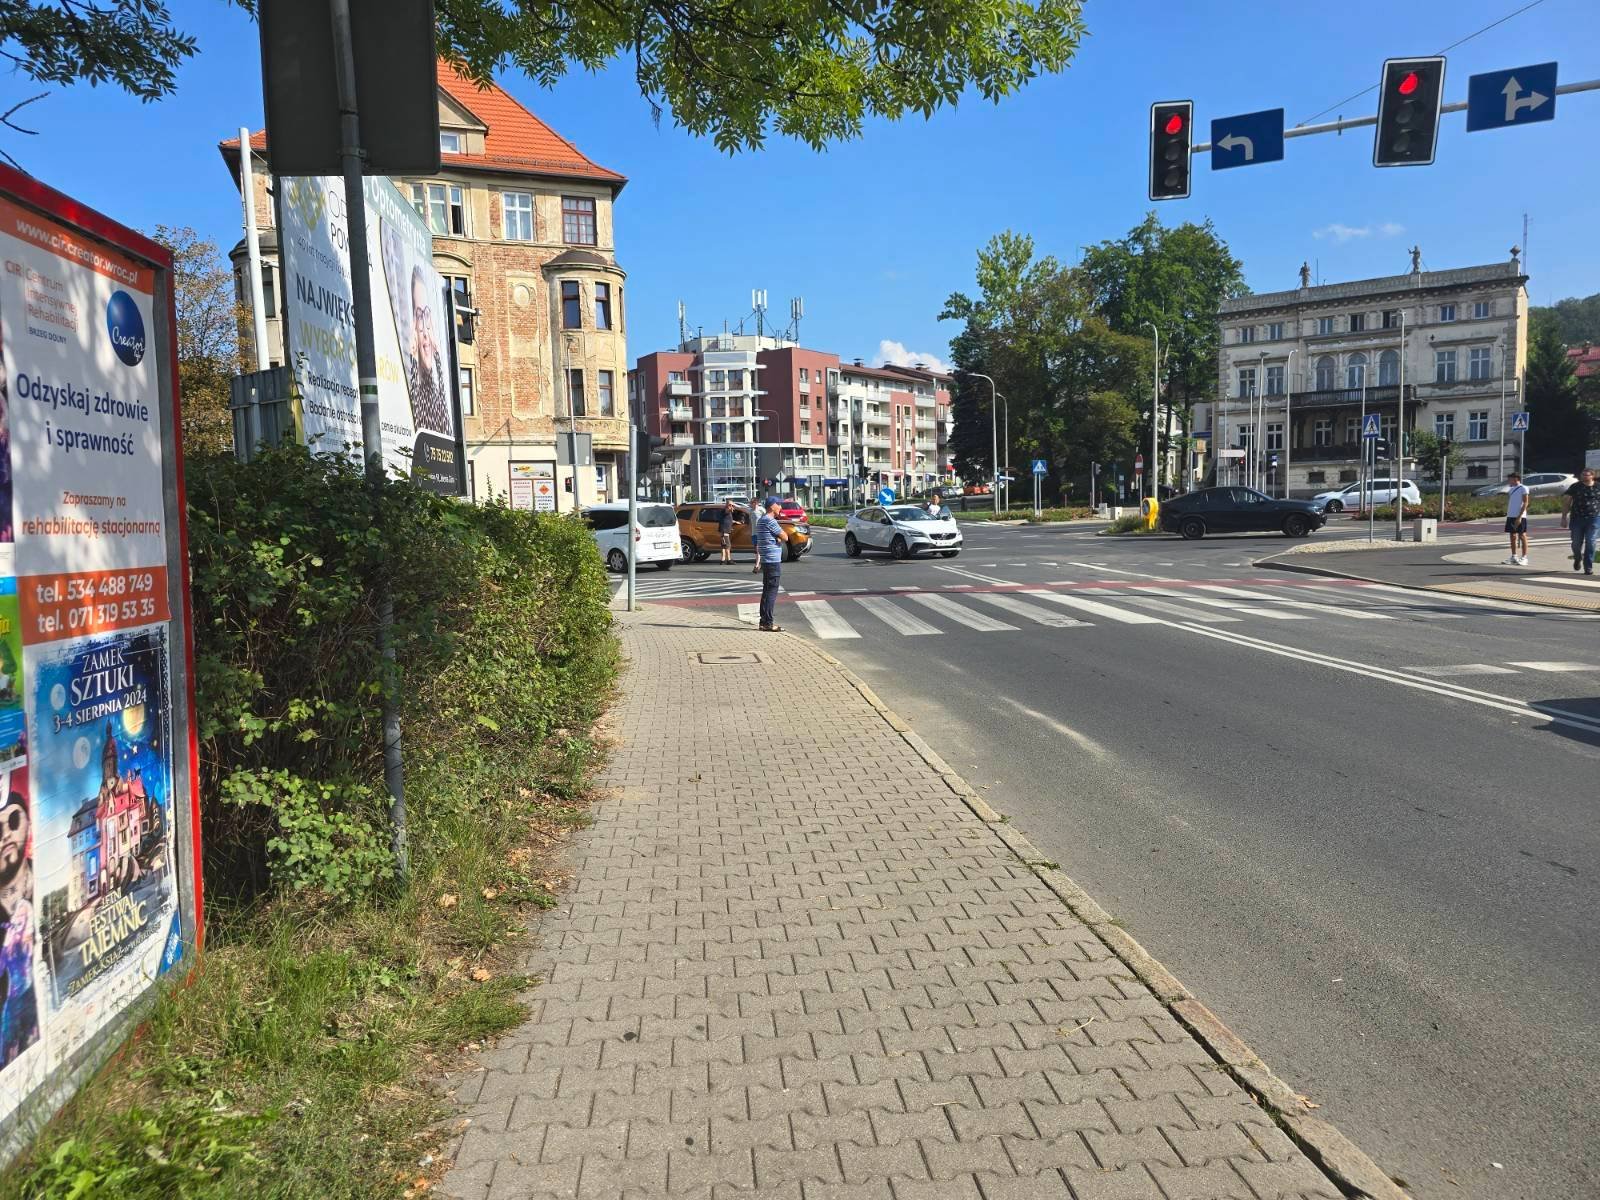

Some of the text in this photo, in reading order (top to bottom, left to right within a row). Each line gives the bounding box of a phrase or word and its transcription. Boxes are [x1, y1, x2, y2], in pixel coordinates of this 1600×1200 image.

[16, 219, 138, 285] www.cir.creator.wroc.pl
[26, 268, 64, 293] Centrum
[27, 287, 77, 316] Intensywnej
[296, 271, 356, 330] NAJWIĘKS
[28, 303, 79, 333] Rehabilitacji
[29, 327, 47, 339] BRZEG
[112, 326, 144, 352] Creator
[17, 373, 148, 422] Odzyskaj zdrowie
[308, 371, 340, 397] Realizacja
[310, 400, 336, 419] Badanie
[47, 421, 134, 456] i sprawność
[64, 491, 126, 508] Zapraszamy na
[22, 517, 160, 539] rehabilitację stacjonarną
[37, 573, 152, 603] tel. 534 488 749
[38, 598, 154, 632] tel. 071 319 53 35
[83, 648, 124, 673] ZAMEK
[71, 664, 134, 706] SZTUKI
[54, 689, 147, 734] 3-4 SIERPNIA 2024
[90, 891, 138, 934] FESTIWAL
[80, 900, 148, 966] TAJEMNIC
